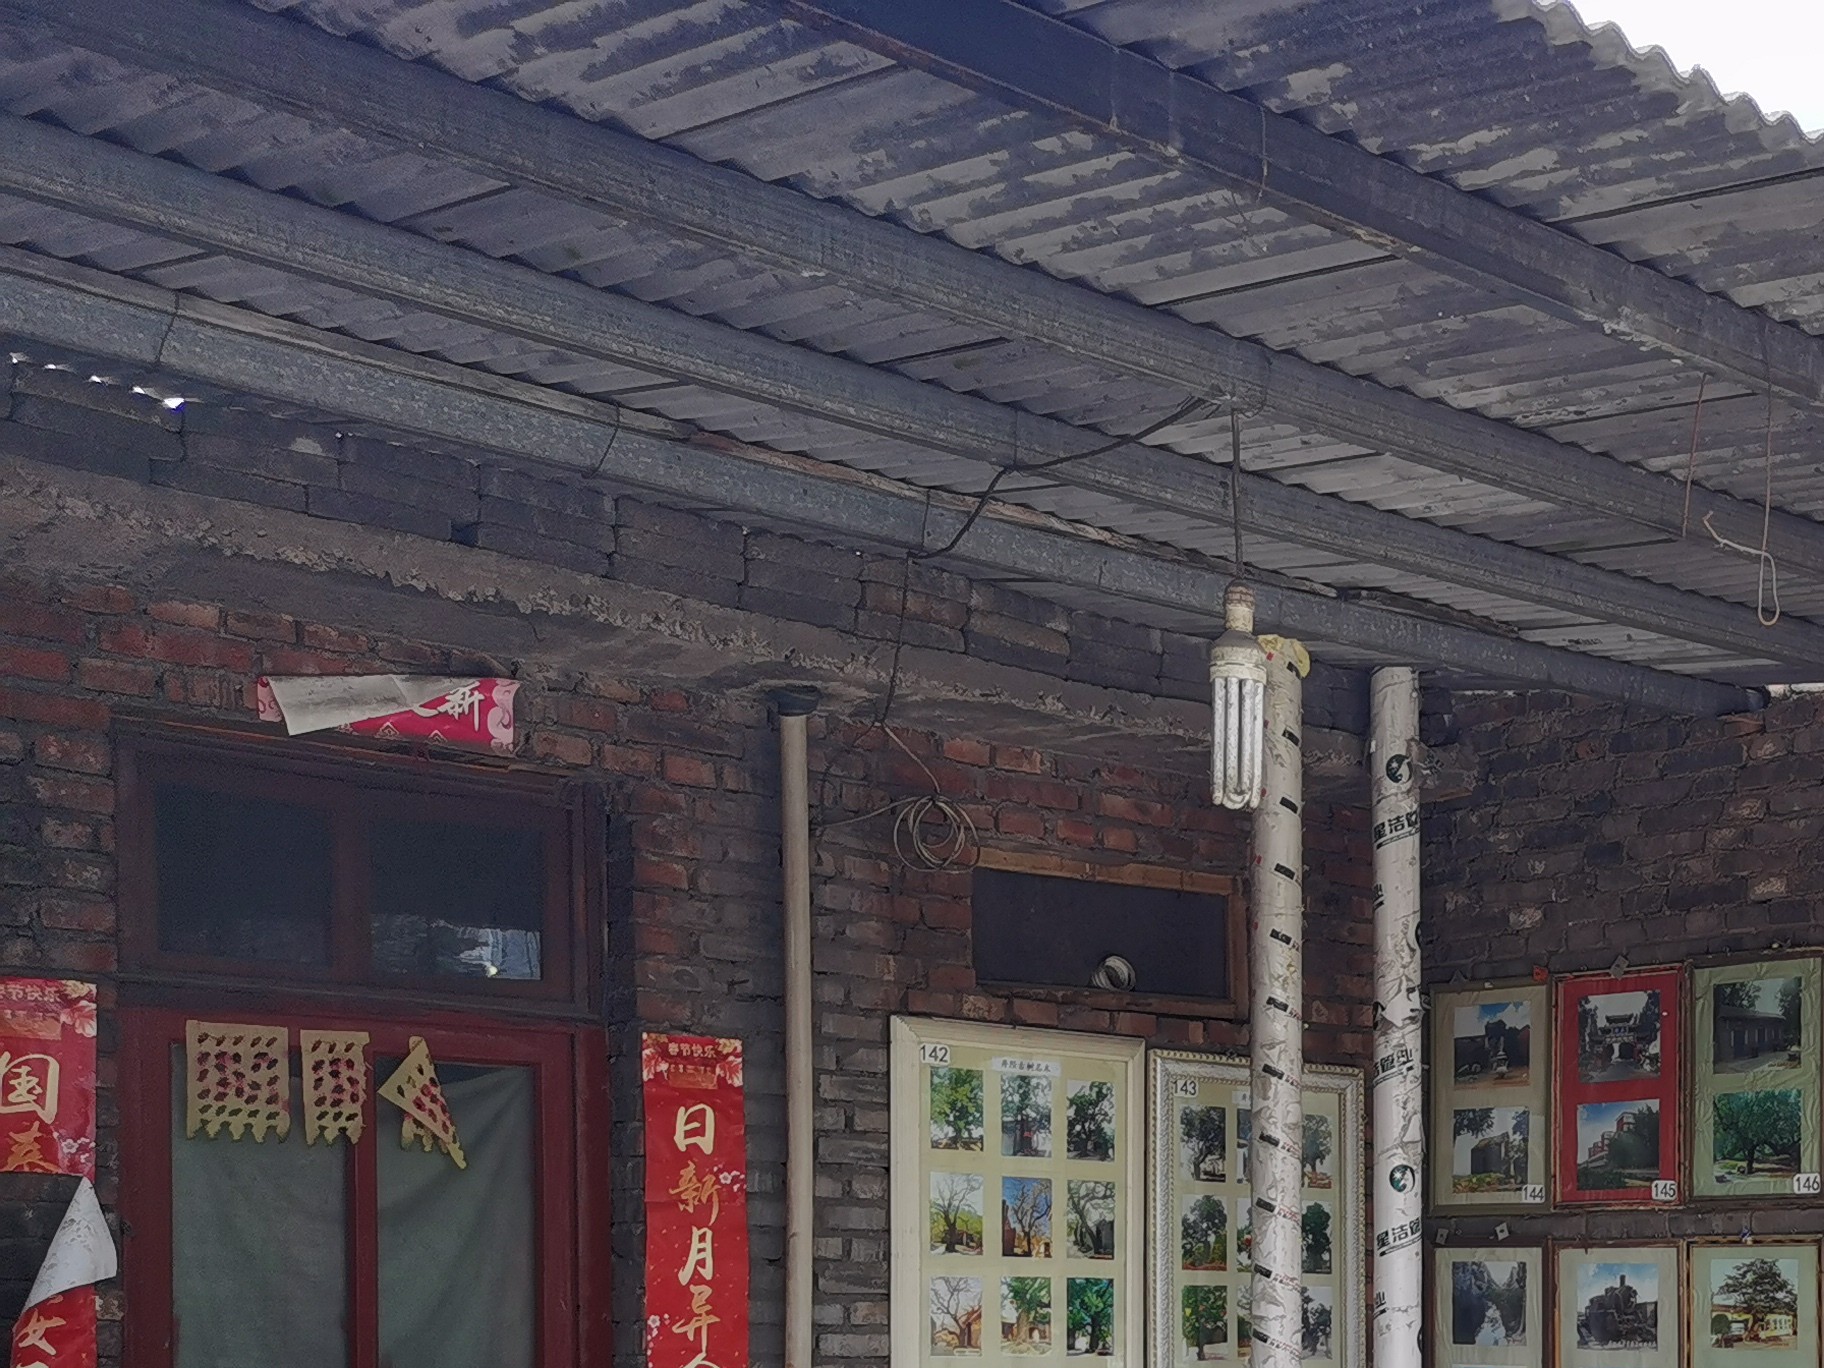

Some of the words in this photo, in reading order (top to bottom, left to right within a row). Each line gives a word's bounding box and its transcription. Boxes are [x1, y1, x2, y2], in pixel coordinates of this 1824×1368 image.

[668, 1042, 717, 1058] 春节快乐
[920, 1045, 949, 1062] 142
[1172, 1081, 1197, 1096] 143
[1654, 1183, 1676, 1197] 145
[1795, 1176, 1818, 1191] 146
[1522, 1186, 1545, 1201] 144
